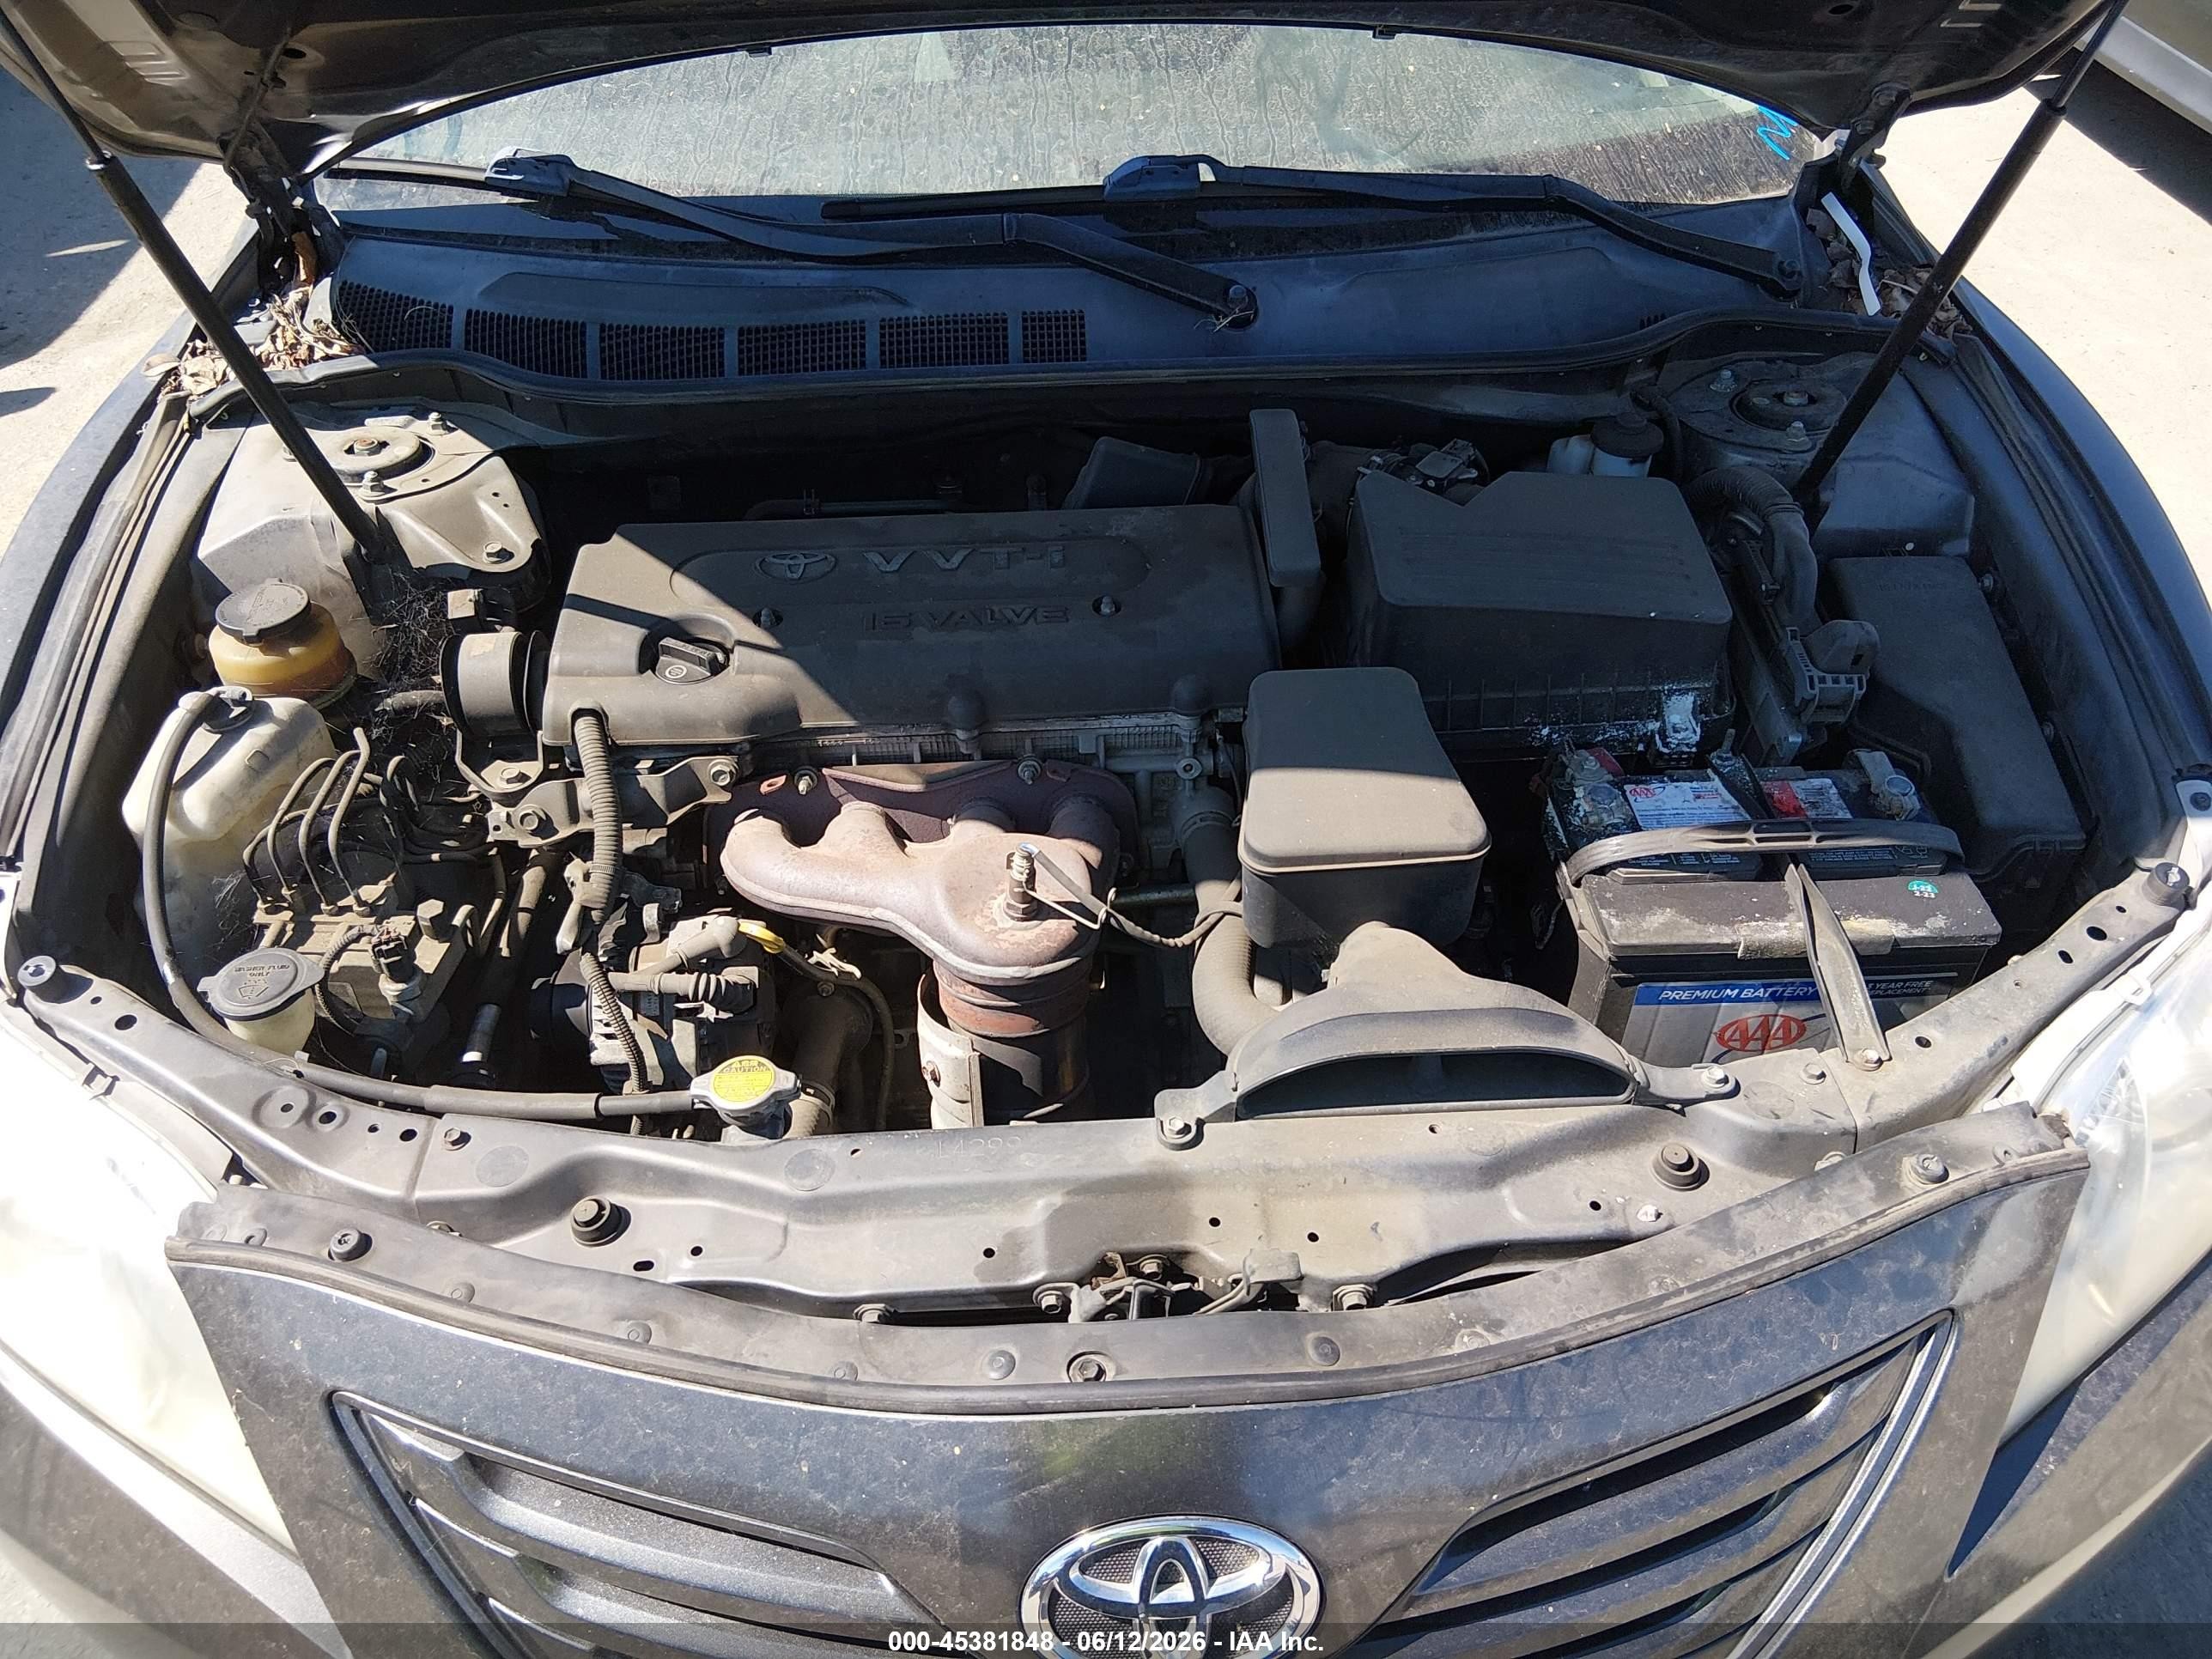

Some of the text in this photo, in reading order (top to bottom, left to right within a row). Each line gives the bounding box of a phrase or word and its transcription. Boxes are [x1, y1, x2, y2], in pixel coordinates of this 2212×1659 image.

[926, 605, 1071, 632] VALVE
[1658, 987, 1819, 1000] PREMIUM BATTERY
[1875, 981, 1904, 990] YEAR
[1904, 980, 1934, 988] FREE
[1719, 1014, 1802, 1052] AAA
